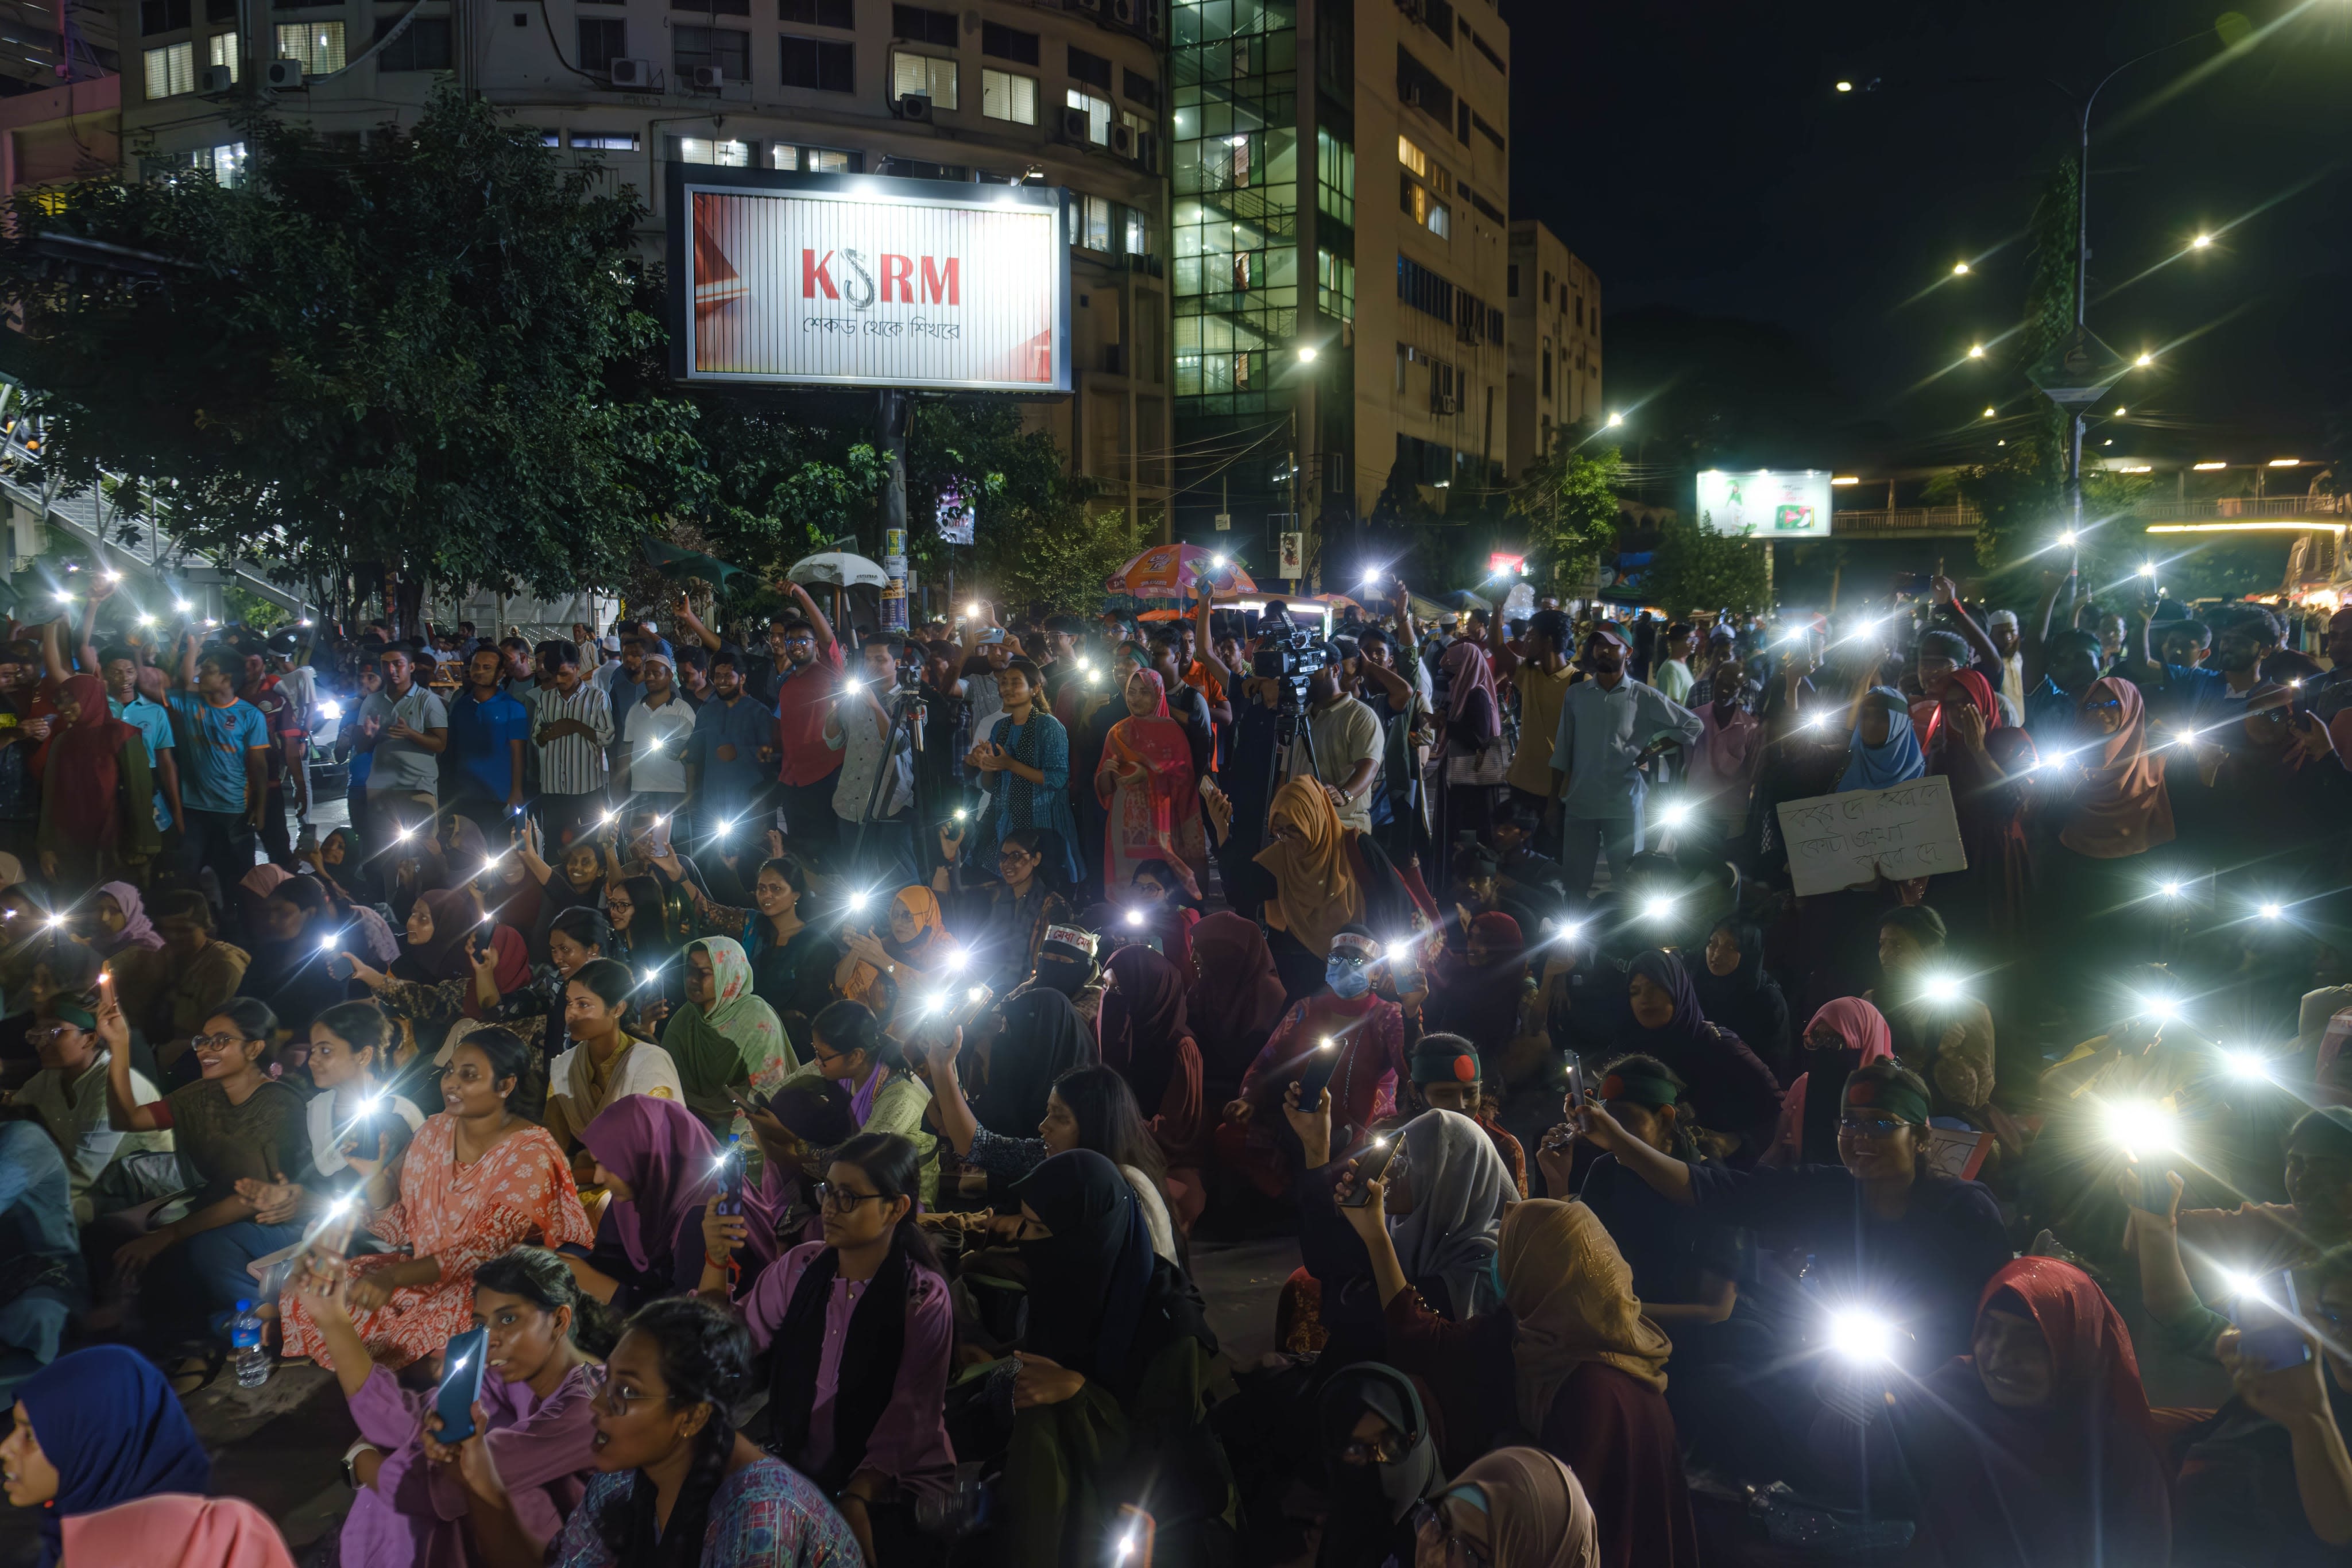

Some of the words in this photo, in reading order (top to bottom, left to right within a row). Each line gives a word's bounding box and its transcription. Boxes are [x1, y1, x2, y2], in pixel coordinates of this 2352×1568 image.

[802, 248, 960, 308] KSRM
[803, 317, 857, 338] শেকড়
[863, 320, 904, 337] থেকে
[910, 316, 960, 339] শিখরে
[1053, 930, 1076, 943] মেধা
